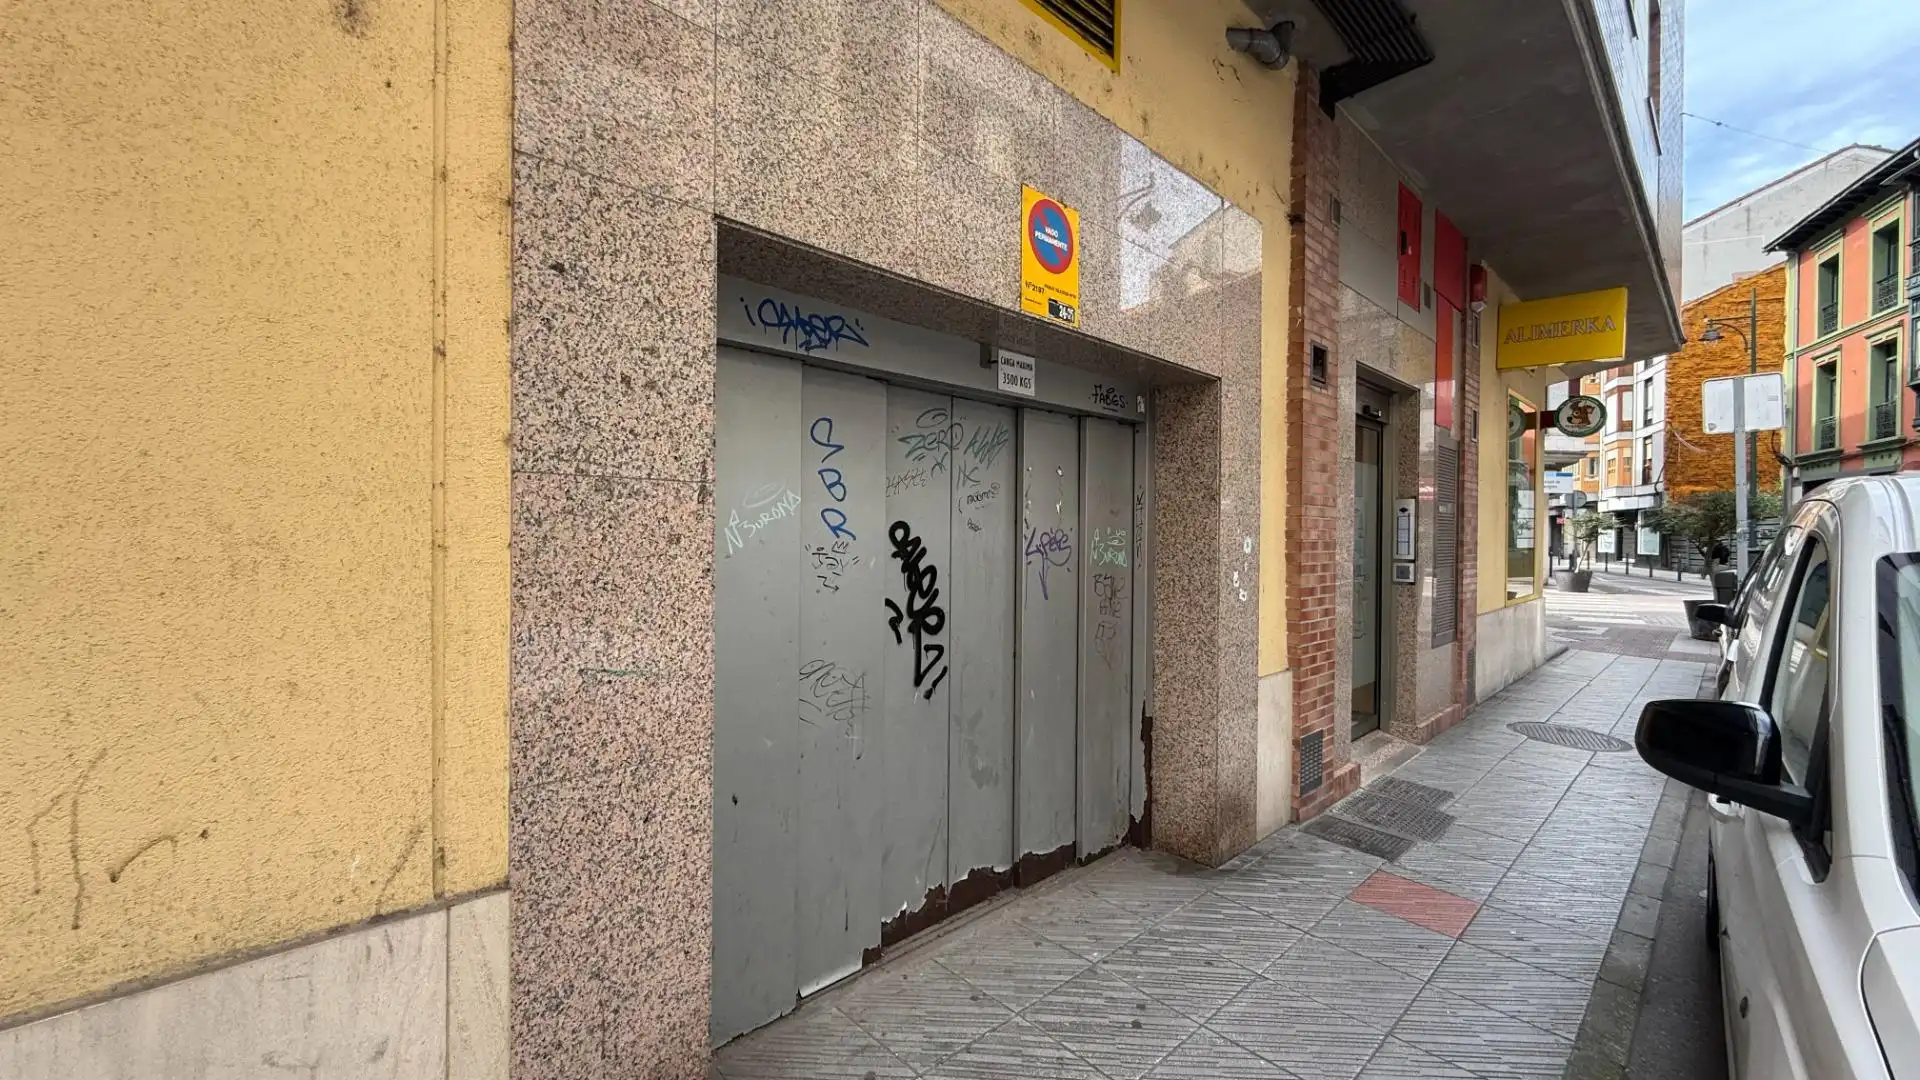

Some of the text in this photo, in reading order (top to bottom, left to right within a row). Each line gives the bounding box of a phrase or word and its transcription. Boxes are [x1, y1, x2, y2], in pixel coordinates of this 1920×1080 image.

[1503, 315, 1616, 344] ALIMERKA
[1000, 355, 1015, 367] CARGA
[1002, 372, 1032, 389] 3500 KGS
